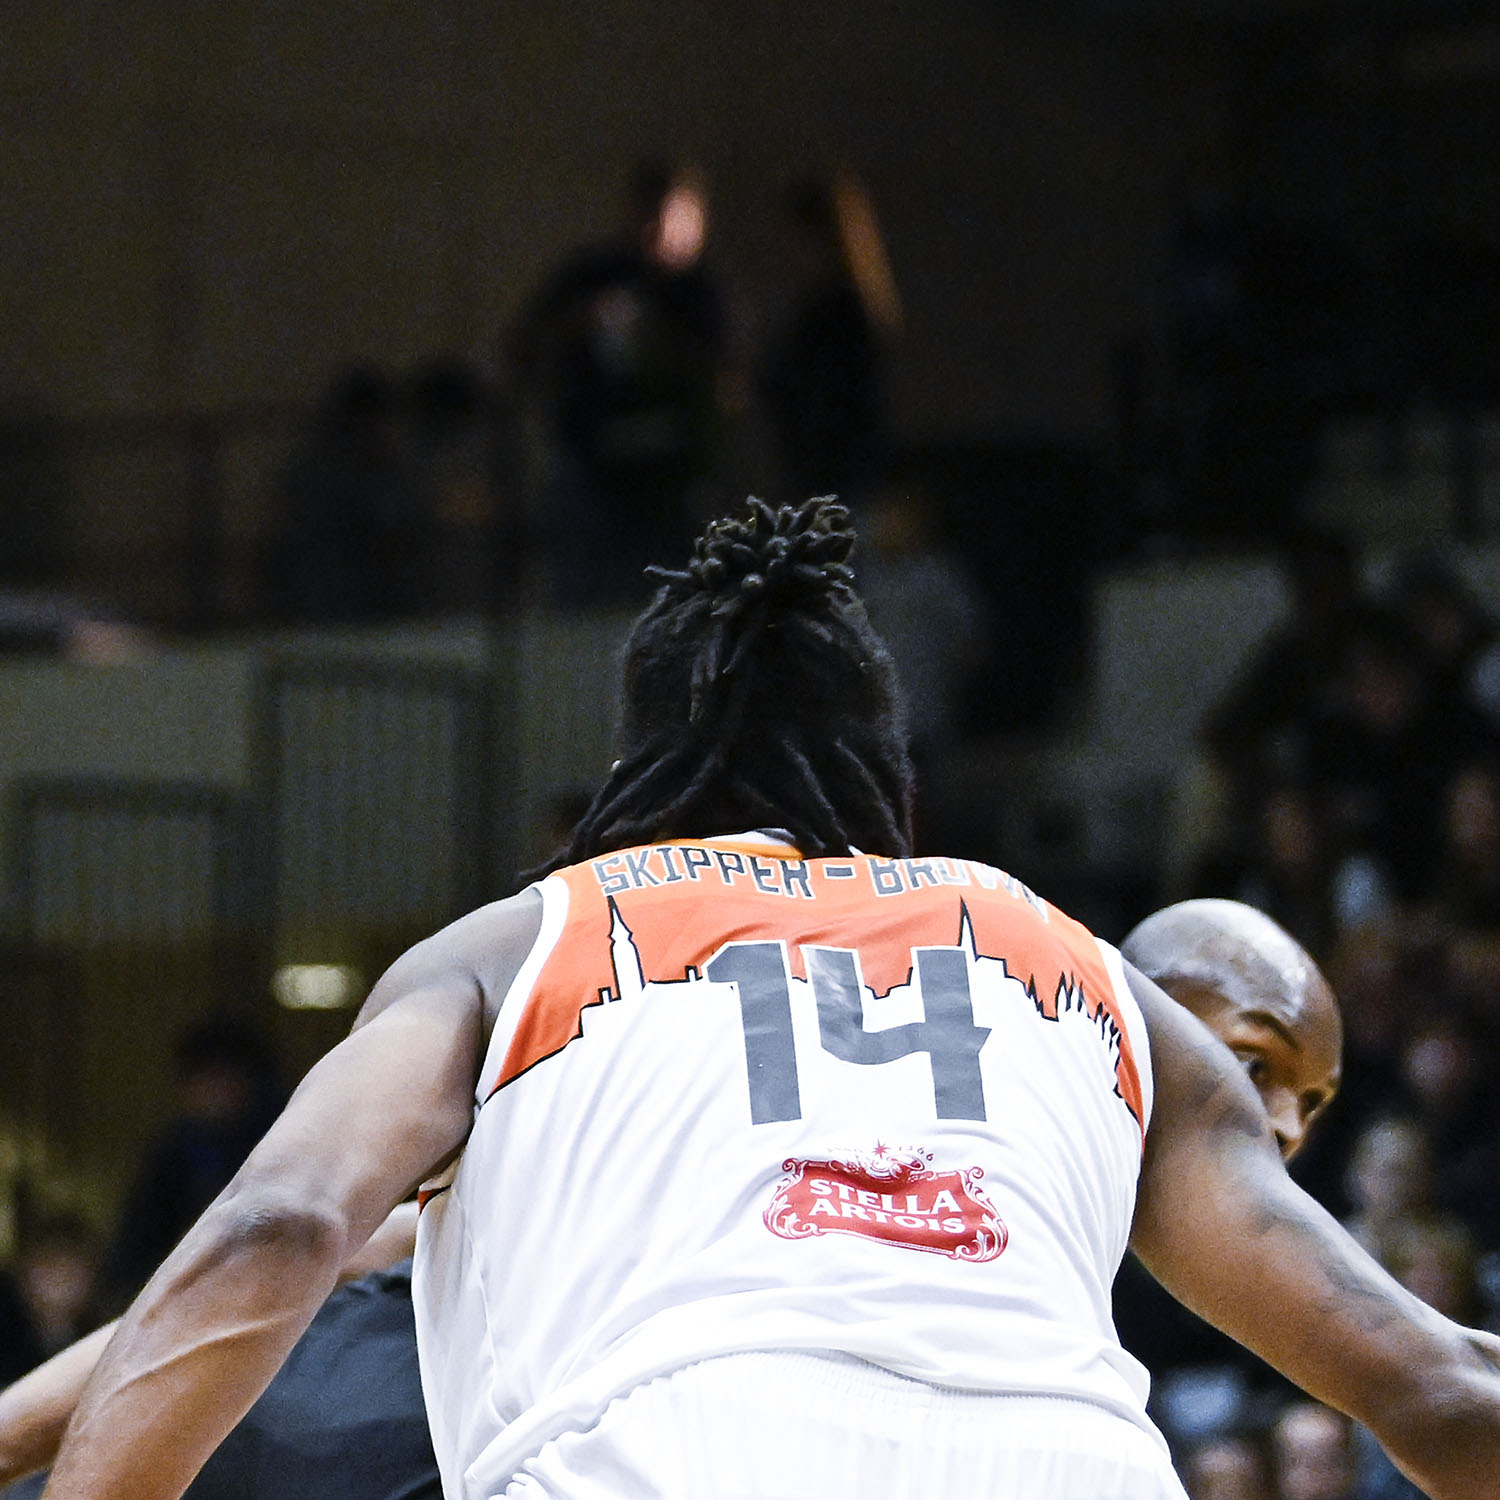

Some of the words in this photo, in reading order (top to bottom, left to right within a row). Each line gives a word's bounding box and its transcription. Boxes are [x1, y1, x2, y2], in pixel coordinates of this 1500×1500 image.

[708, 940, 991, 1125] 14
[808, 1178, 964, 1216] STELLA
[808, 1197, 967, 1234] ARTOIS
